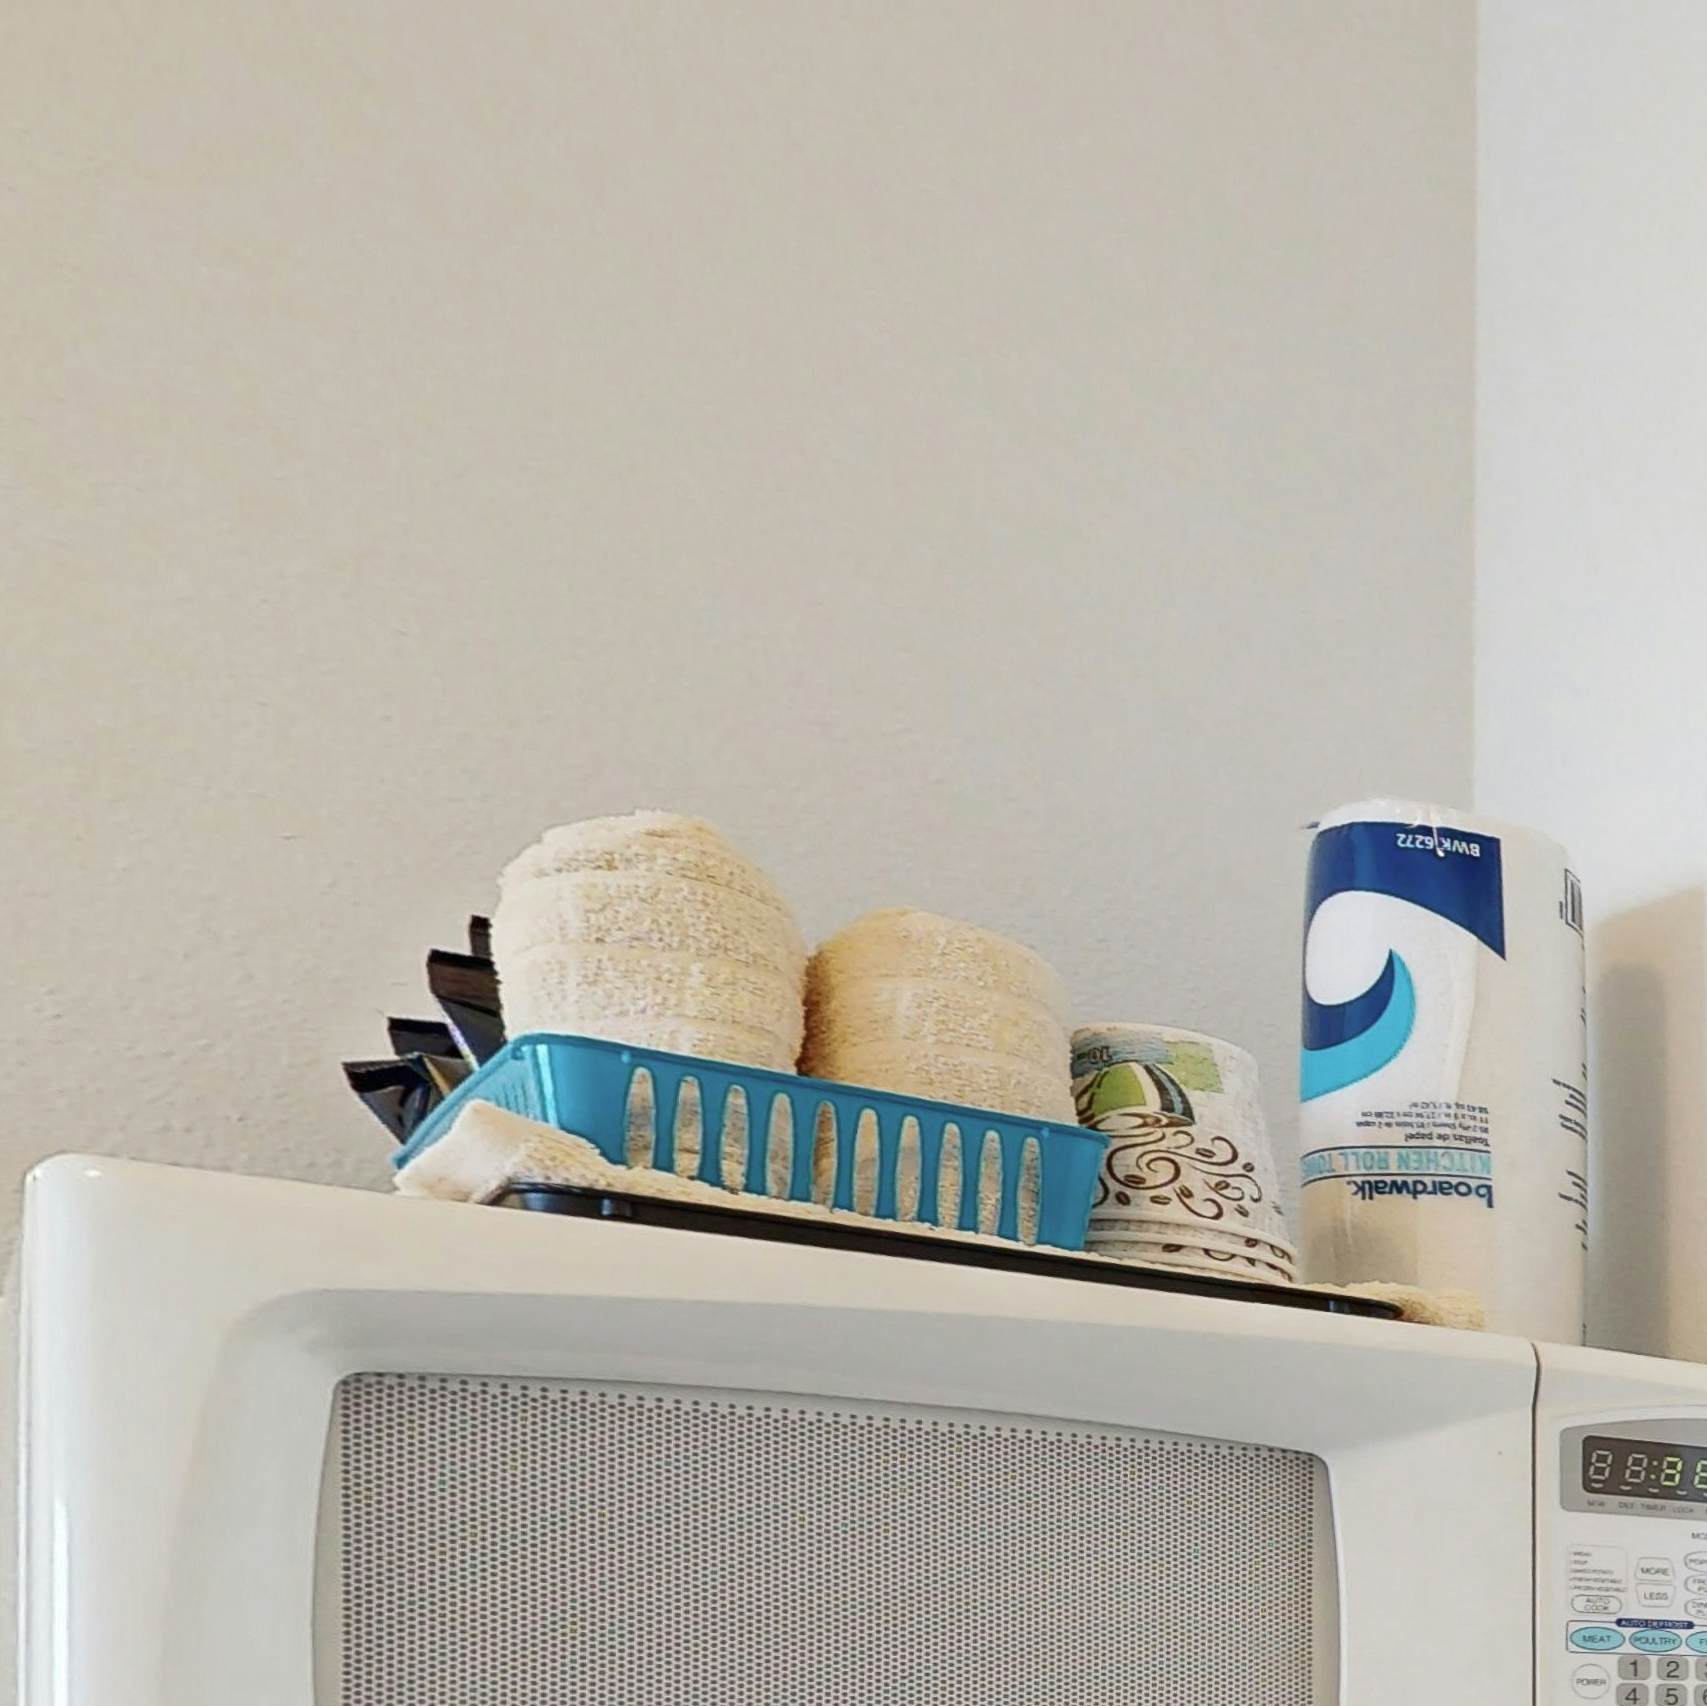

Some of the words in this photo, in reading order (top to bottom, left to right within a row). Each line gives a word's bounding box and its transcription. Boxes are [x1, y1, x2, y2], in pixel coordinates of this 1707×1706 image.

[1396, 833, 1434, 850] 6272
[1438, 836, 1481, 857] BWK
[1404, 1131, 1433, 1142] papel
[1436, 1133, 1450, 1143] de
[1339, 1151, 1390, 1173] ROLL
[1397, 1150, 1493, 1176] KITCHEN
[1640, 1567, 1671, 1576] MORE
[1643, 1591, 1669, 1600] LESS
[1620, 1619, 1646, 1628] AUTO
[1582, 1634, 1612, 1643] MEAT
[1633, 1635, 1677, 1645] POULTRY
[1630, 1660, 1638, 1678] 1
[1665, 1660, 1680, 1679] 2
[1575, 1678, 1607, 1687] POWER
[1624, 1687, 1640, 1705] 4
[1664, 1688, 1679, 1706] 5
